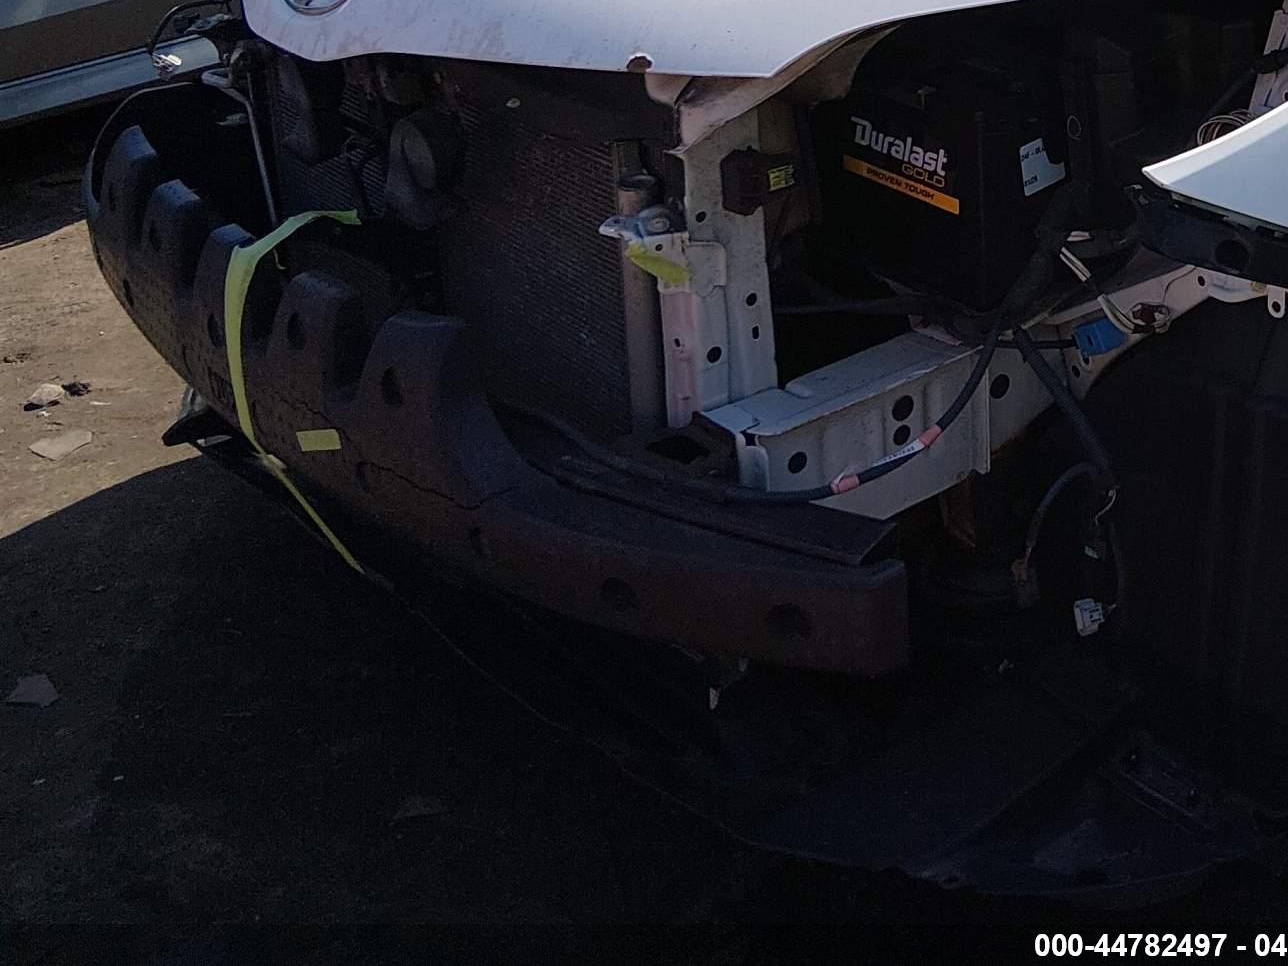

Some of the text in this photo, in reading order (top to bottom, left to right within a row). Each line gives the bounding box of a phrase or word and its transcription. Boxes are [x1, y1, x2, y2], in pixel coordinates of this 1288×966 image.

[849, 115, 948, 177] Duralast
[867, 167, 935, 200] PROVEN TOUGH
[901, 163, 945, 188] GOLD
